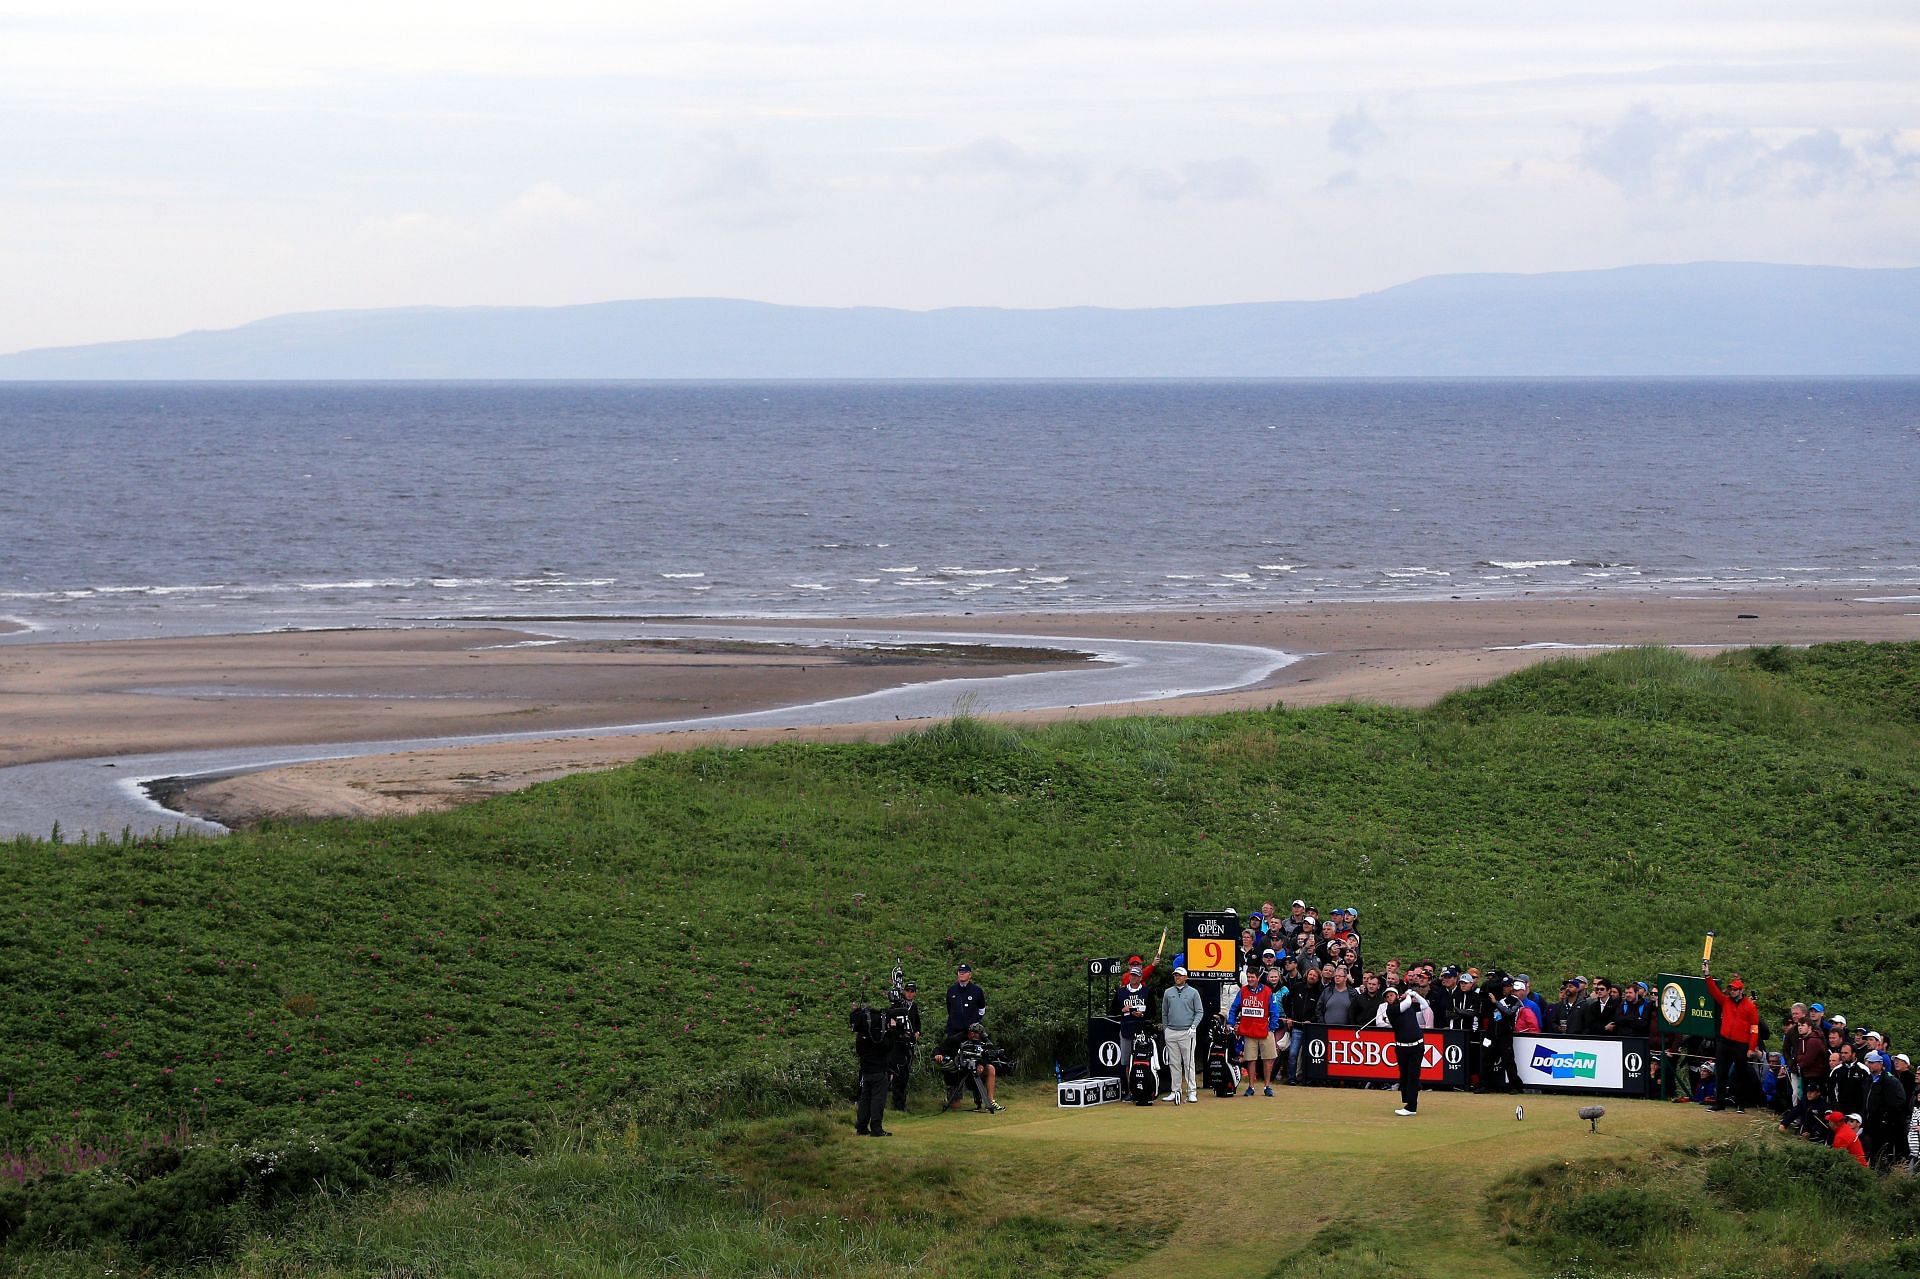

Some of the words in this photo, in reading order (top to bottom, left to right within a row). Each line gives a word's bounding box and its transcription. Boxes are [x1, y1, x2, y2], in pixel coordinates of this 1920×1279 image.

[1198, 924, 1225, 934] OPEN
[1205, 942, 1222, 968] 9
[1123, 998, 1145, 1006] OPEN
[1242, 999, 1264, 1008] OPEN
[1243, 1008, 1262, 1016] JOHNSTON
[1691, 1009, 1713, 1018] ROLEX
[1328, 1039, 1398, 1067] HSBC
[1532, 1057, 1595, 1069] DOOSAN
